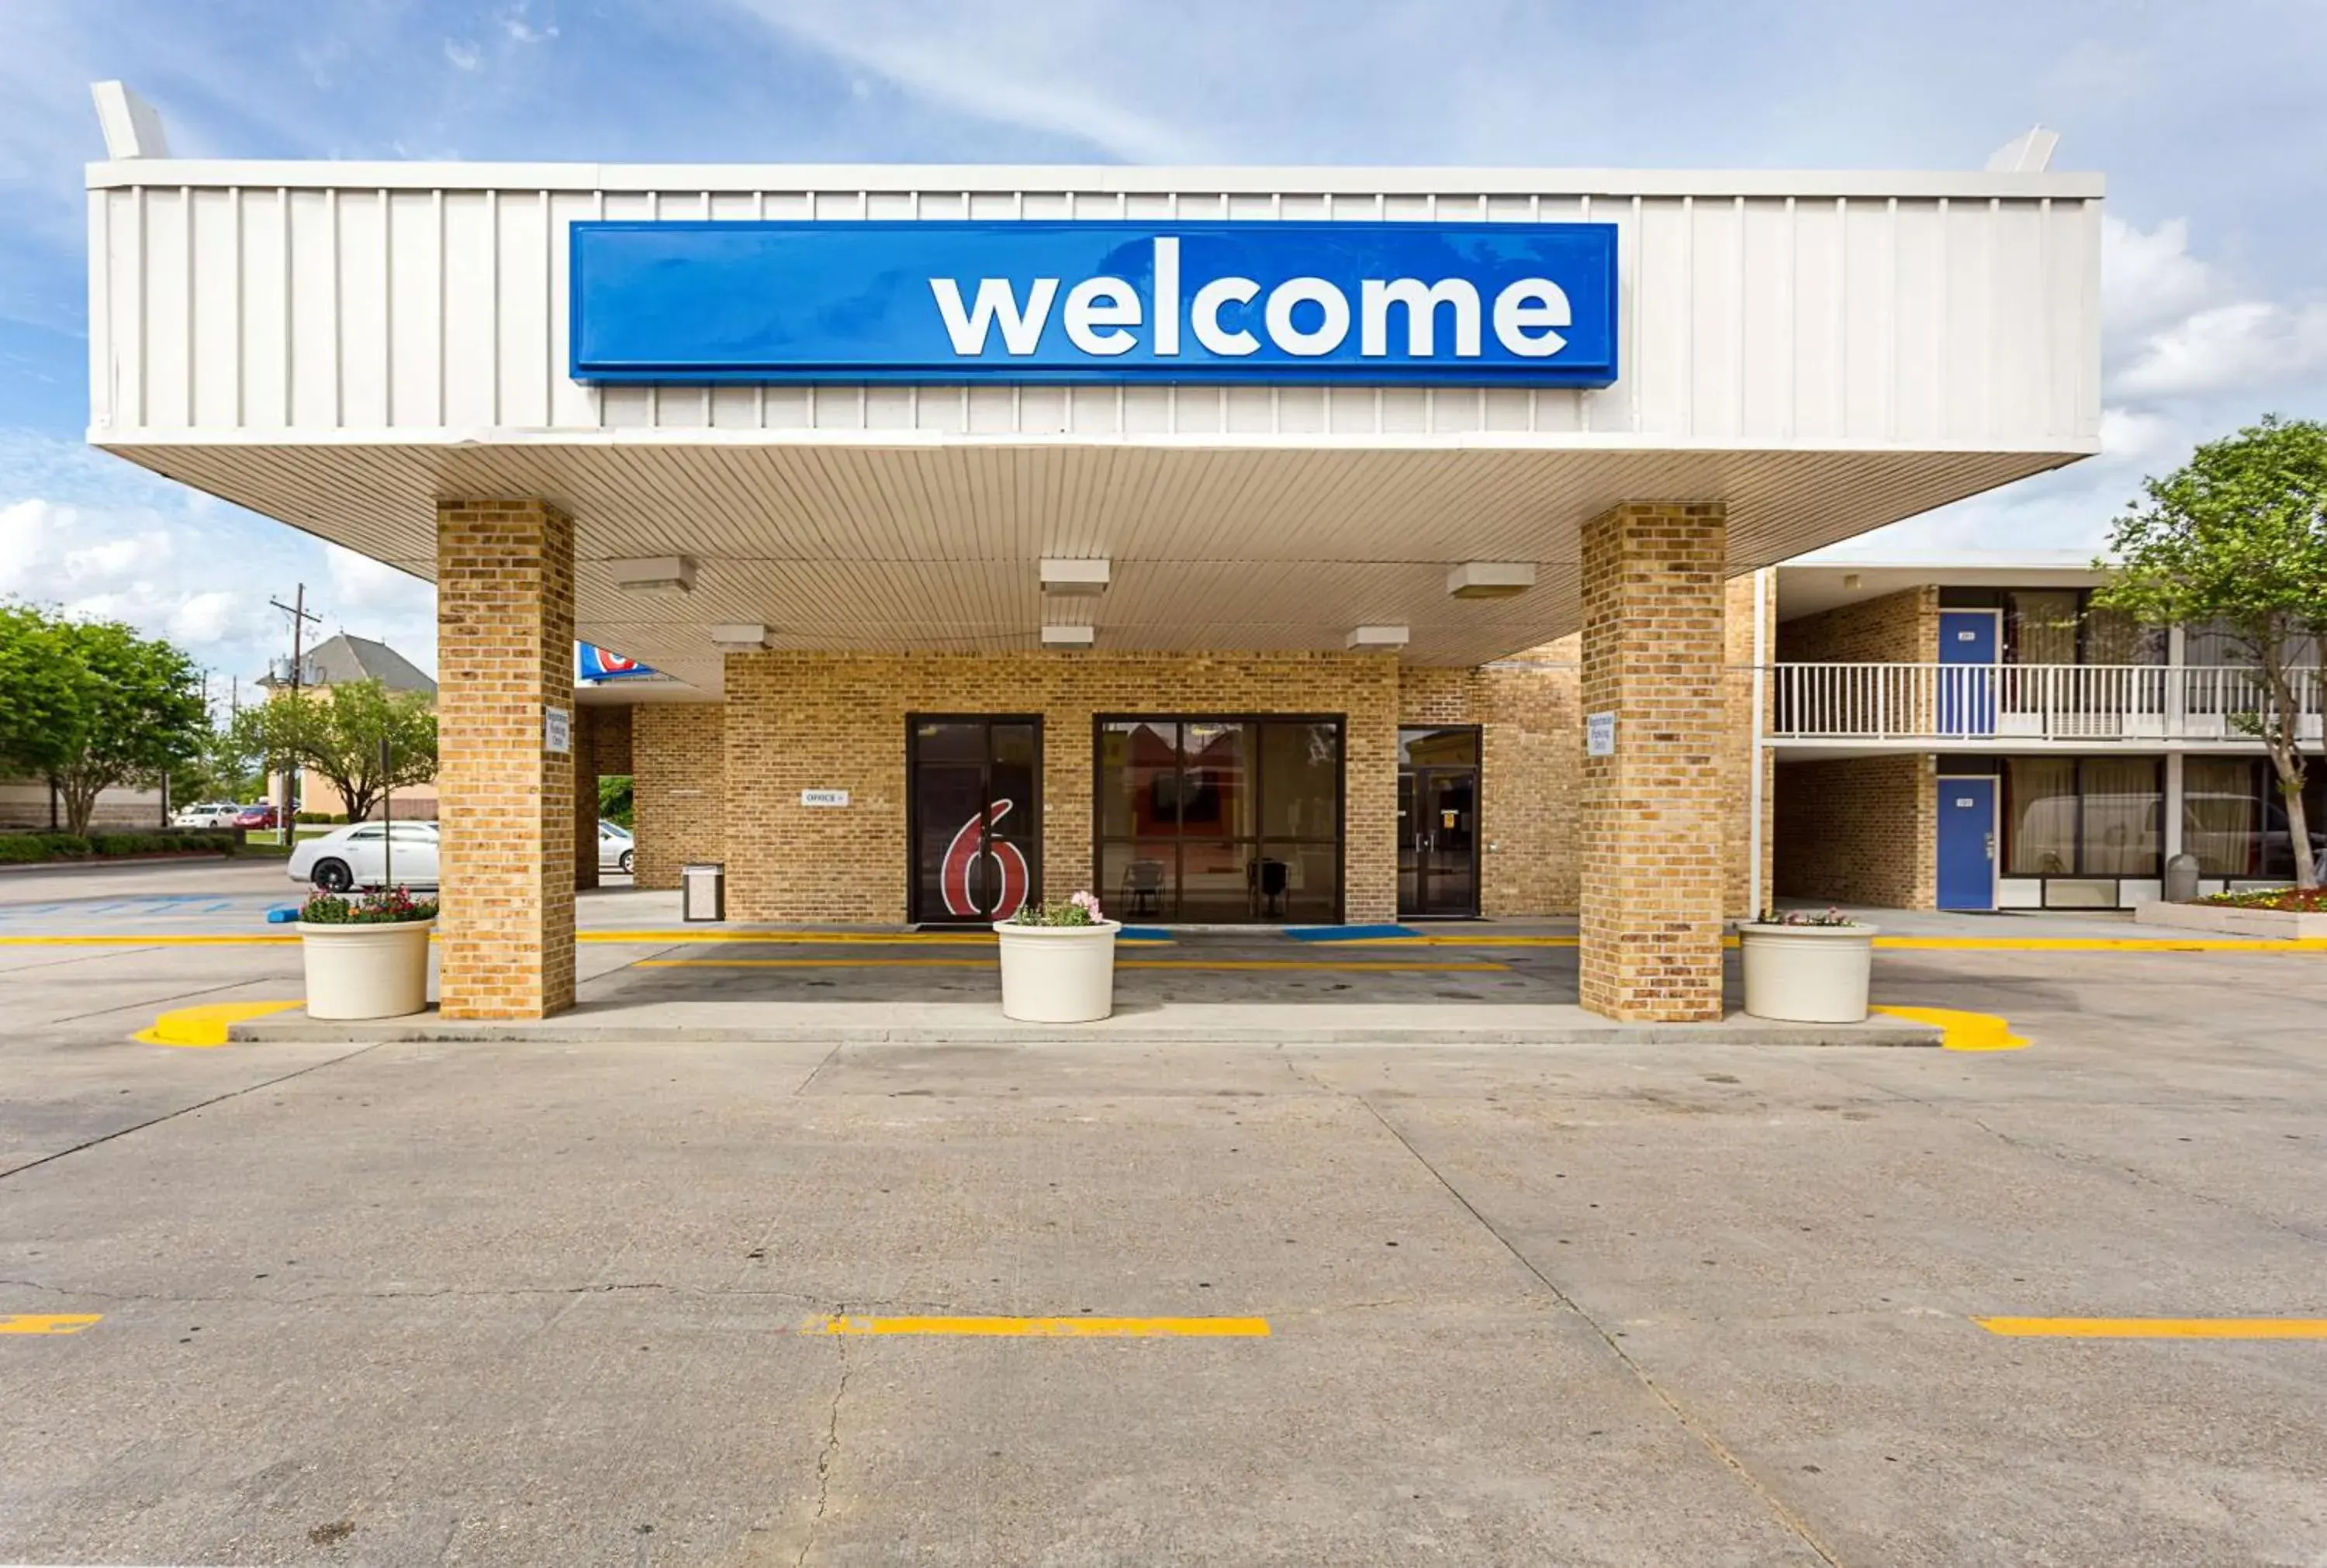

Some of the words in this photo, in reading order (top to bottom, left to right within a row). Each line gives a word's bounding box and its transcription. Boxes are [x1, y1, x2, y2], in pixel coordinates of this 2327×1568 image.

[929, 237, 1572, 356] welcome
[807, 793, 835, 803] OFFICE
[940, 798, 1029, 920] 6
